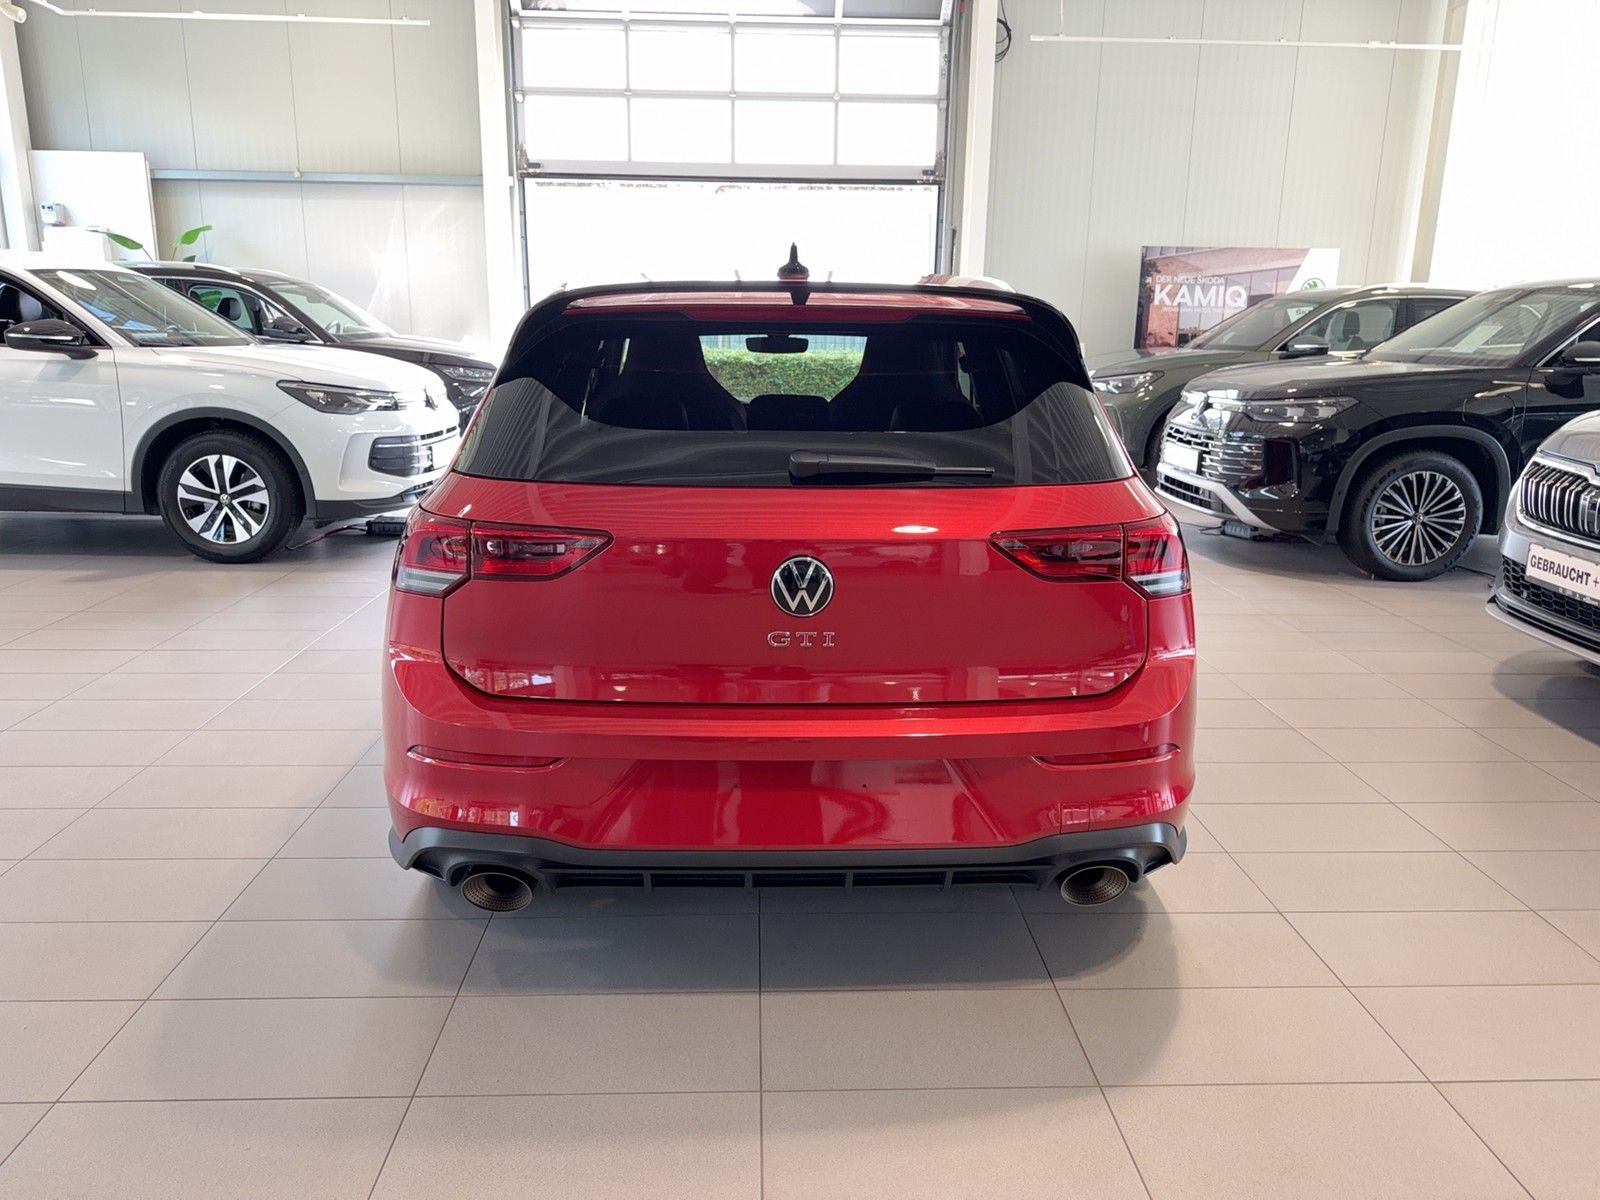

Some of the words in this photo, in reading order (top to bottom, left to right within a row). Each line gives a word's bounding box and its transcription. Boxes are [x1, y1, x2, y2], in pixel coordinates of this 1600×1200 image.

[1156, 275, 1172, 284] DER
[1174, 275, 1195, 284] NEUE
[1154, 284, 1248, 308] KAMIQ
[1530, 555, 1591, 586] GEBRAUCHT
[774, 559, 831, 613] VW
[767, 631, 835, 647] GTI
